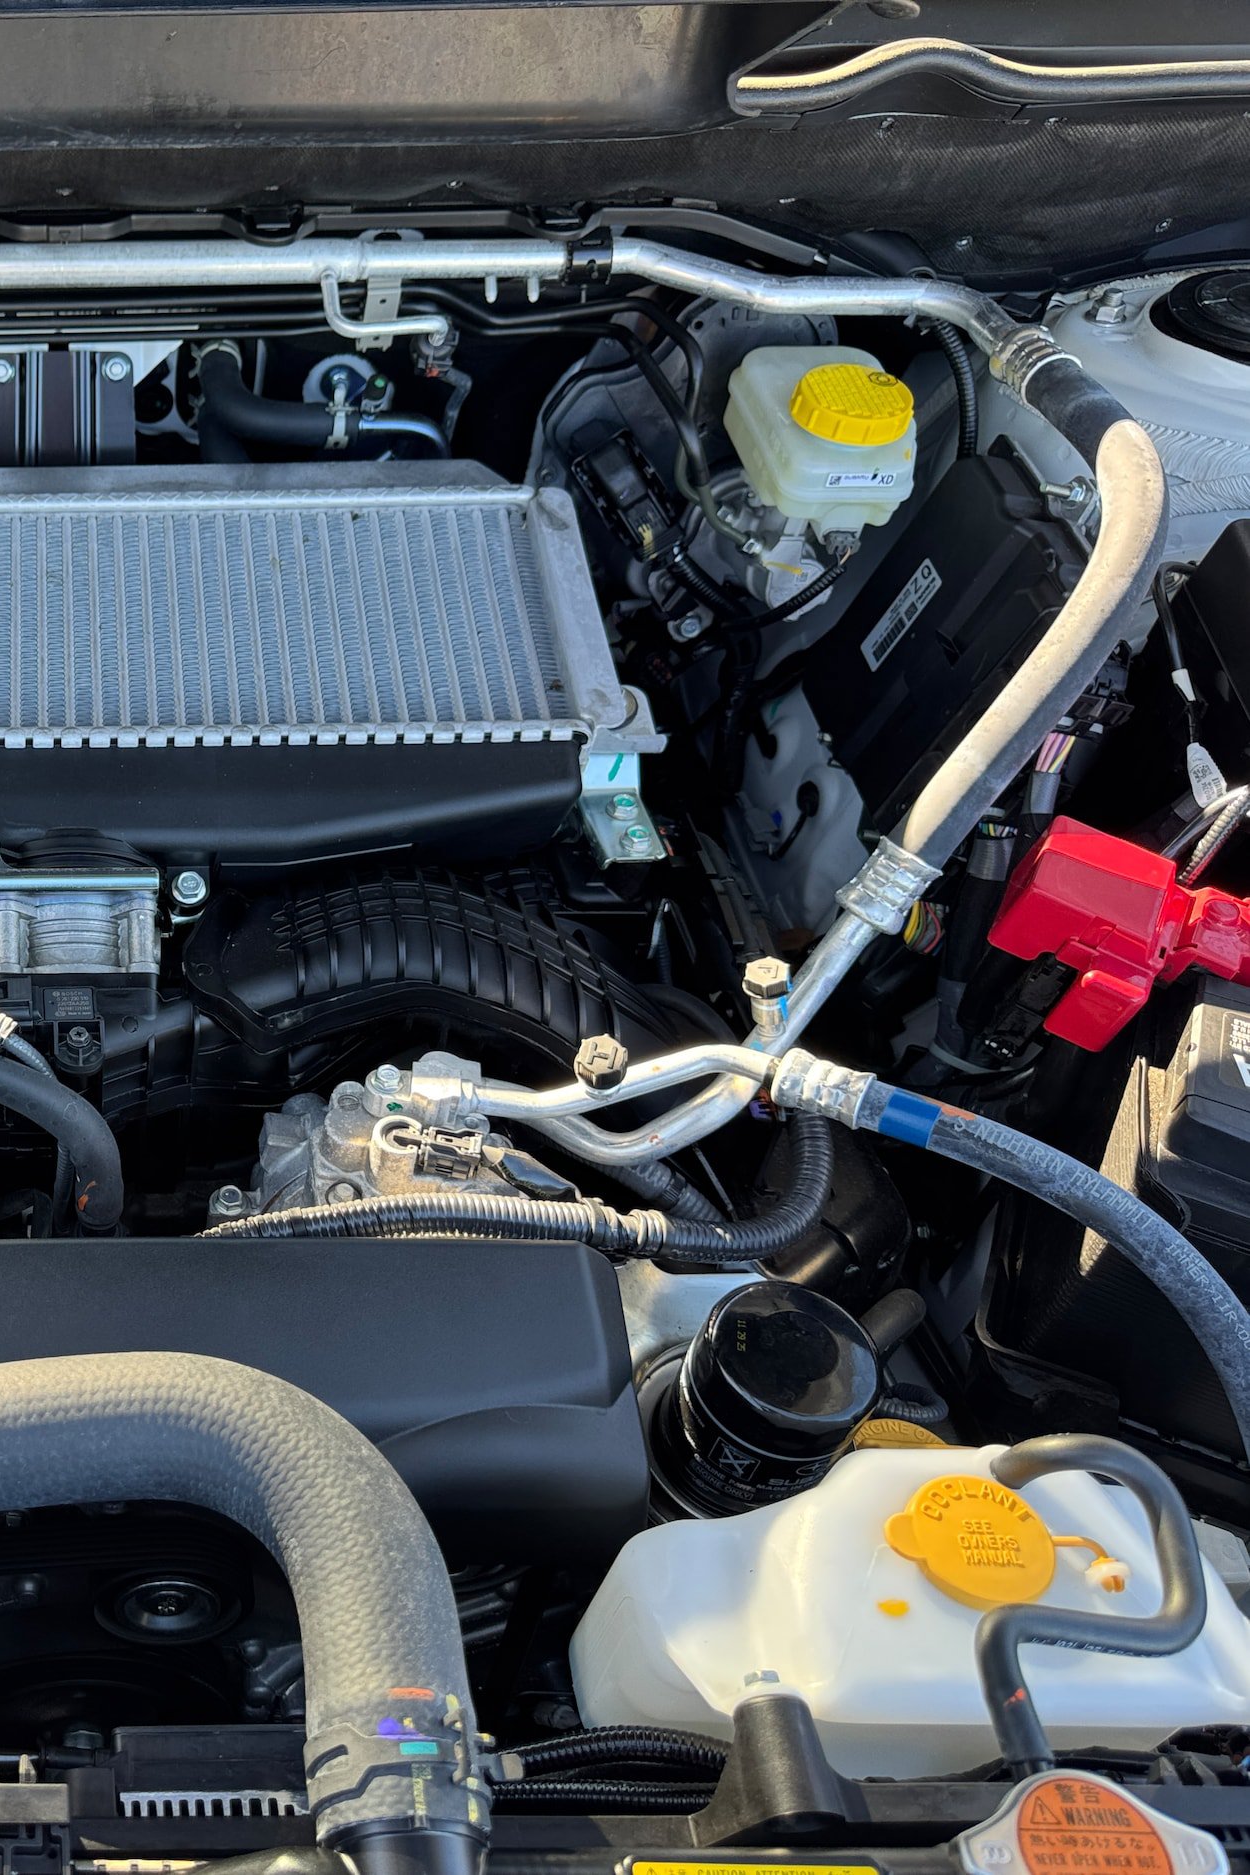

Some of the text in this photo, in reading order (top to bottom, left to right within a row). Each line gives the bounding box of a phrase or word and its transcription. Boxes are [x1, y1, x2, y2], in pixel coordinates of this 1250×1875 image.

[877, 474, 894, 485] XD
[587, 1042, 618, 1070] H
[974, 1124, 1067, 1174] NICHIRIN
[1070, 1167, 1155, 1229] HYLAMMIT
[921, 1480, 1035, 1522] COOLANT
[962, 1519, 994, 1535] SEE
[957, 1534, 1021, 1551] OWNERS
[961, 1550, 1026, 1569] MANUAL
[1054, 1783, 1100, 1804] 警告
[1061, 1807, 1132, 1827] WARNING
